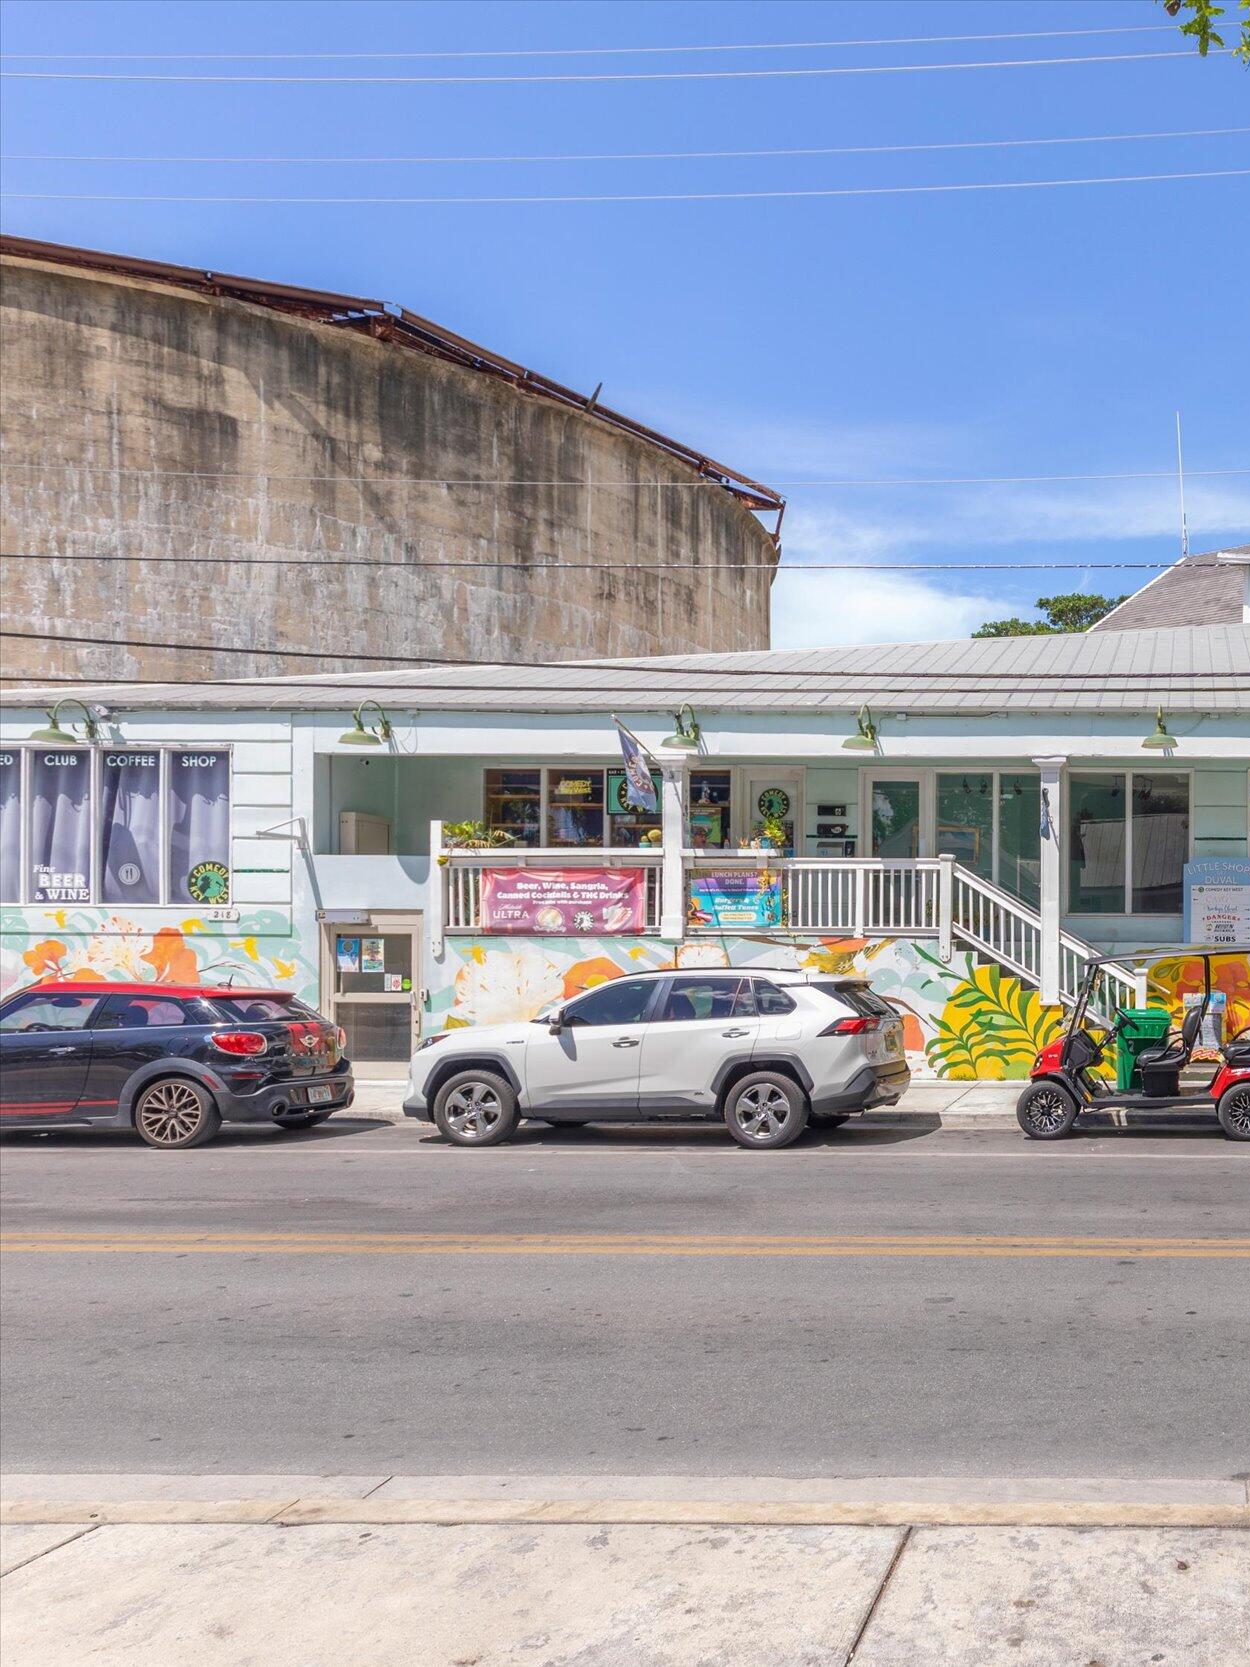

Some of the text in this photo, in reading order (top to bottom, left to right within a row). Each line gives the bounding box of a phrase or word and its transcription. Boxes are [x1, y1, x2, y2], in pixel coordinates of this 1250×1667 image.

[44, 755, 78, 766] CLUB
[106, 755, 155, 767] COFFEE
[181, 756, 217, 767] SHOP
[33, 864, 56, 874] Fine
[193, 863, 230, 878] COMEDY
[1187, 862, 1220, 875] LITTLE
[38, 873, 87, 889] BEER
[1205, 876, 1238, 884] DUVAL
[516, 882, 609, 891] Beer, Wine, Sangria,
[34, 888, 91, 901] & WINE
[189, 885, 206, 902] KEY
[496, 891, 530, 899] Canned
[531, 891, 571, 899] Cocktails
[581, 891, 598, 899] THC
[599, 891, 630, 900] Drinks
[213, 910, 232, 919] 218
[493, 910, 530, 919] ULTRA
